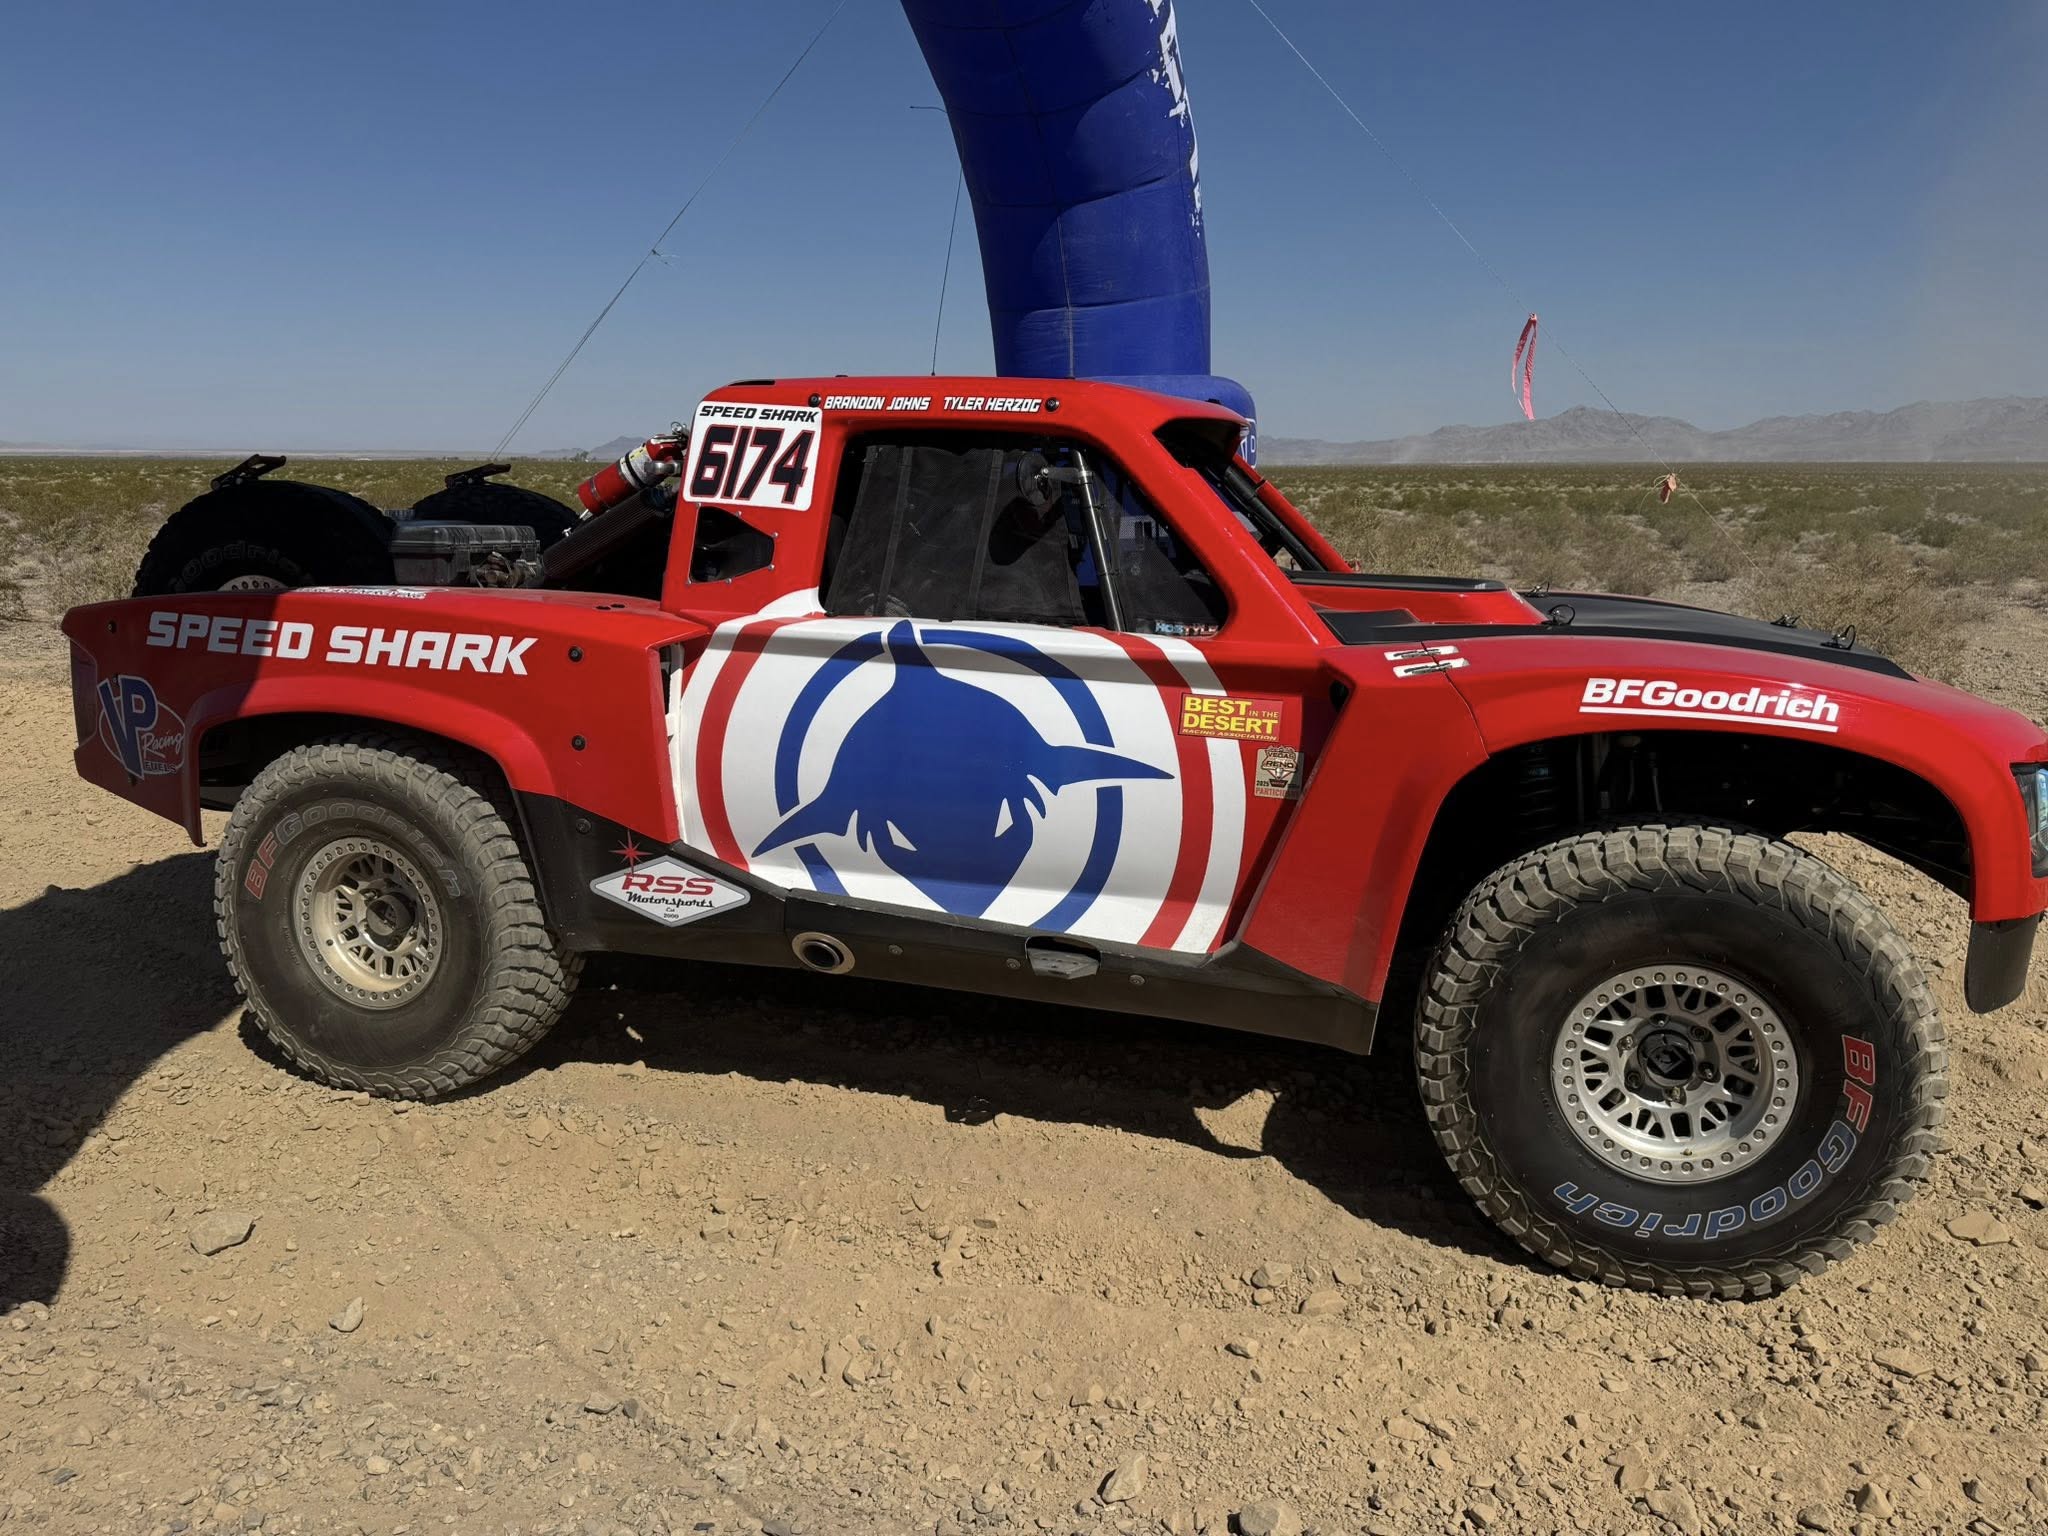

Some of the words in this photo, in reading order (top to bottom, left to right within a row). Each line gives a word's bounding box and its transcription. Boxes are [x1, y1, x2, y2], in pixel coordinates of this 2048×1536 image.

[700, 405, 757, 419] SPEED
[758, 408, 819, 423] SHARK
[823, 396, 885, 410] BRANDON
[886, 397, 931, 411] JOHNS
[943, 397, 985, 411] TYLER
[985, 398, 1043, 412] HERZOG
[690, 423, 816, 504] 6174
[146, 611, 315, 660] SPEED
[325, 625, 539, 676] SHARK
[1184, 696, 1252, 716] BEST
[1261, 710, 1279, 718] THE
[1581, 677, 1840, 723] BFGoodrich
[97, 674, 158, 780] VP
[1182, 728, 1216, 736] RACING
[1217, 731, 1278, 741] ASSOCIATION
[1183, 712, 1279, 735] DESERT
[142, 730, 184, 759] Racing
[143, 760, 177, 773] FUELS
[1266, 760, 1294, 769] RENO
[244, 802, 462, 900] BFGoodrich
[621, 873, 716, 896] RSS
[625, 891, 715, 908] Motorsports
[1553, 1034, 1876, 1239] BFGoodrich
